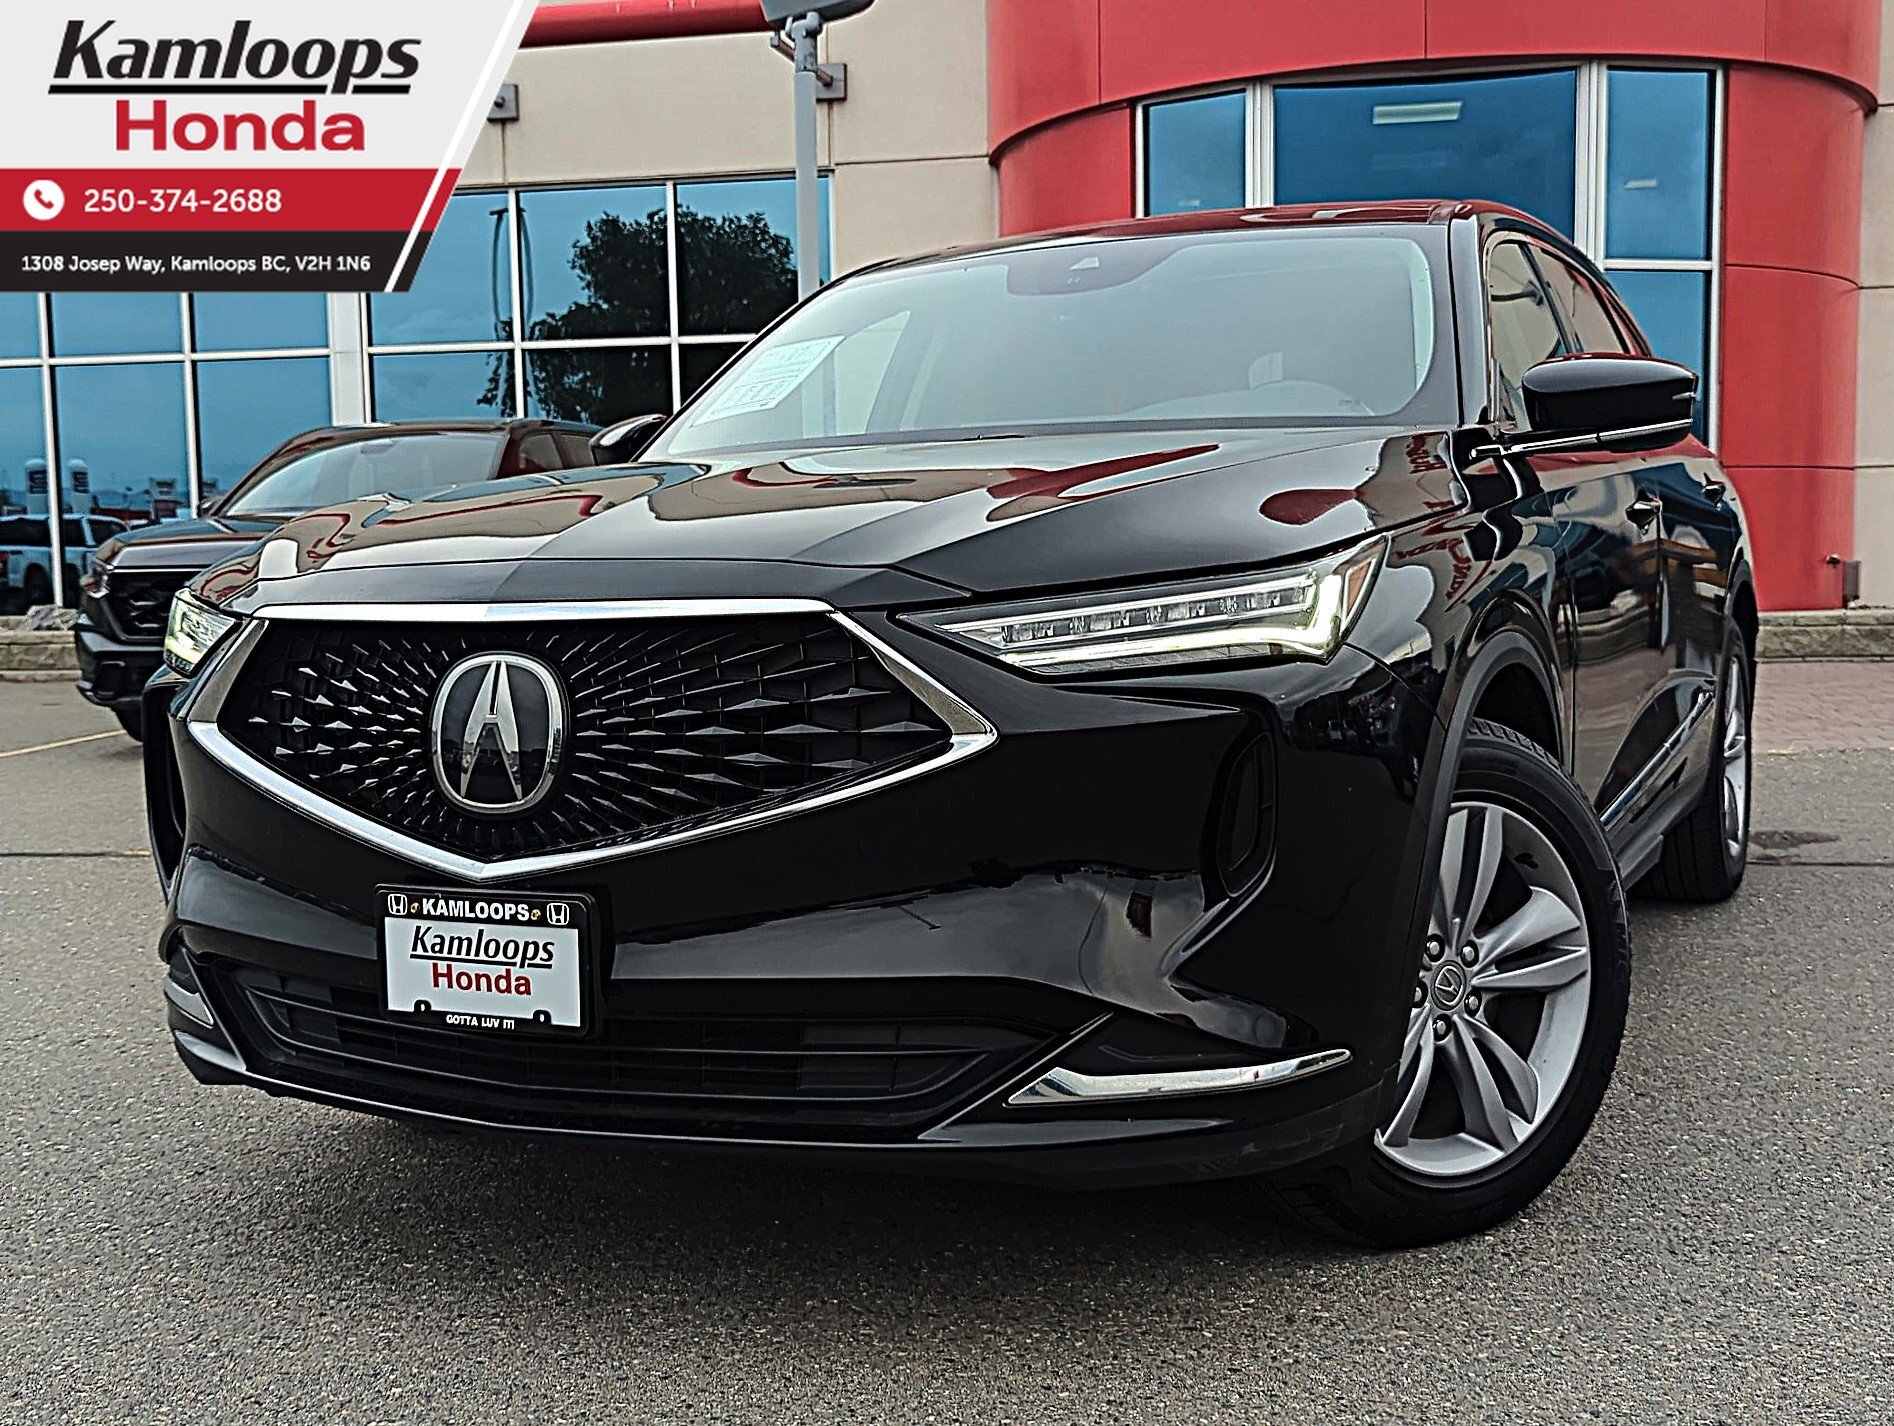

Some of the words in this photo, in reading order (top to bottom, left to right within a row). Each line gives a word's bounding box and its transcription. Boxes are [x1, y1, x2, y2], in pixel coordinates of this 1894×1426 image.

[422, 898, 530, 920] KAMLOOPS
[411, 925, 555, 968] Kamloops
[432, 963, 532, 995] Honda
[446, 1014, 478, 1026] GOTTA
[481, 1017, 499, 1028] LUV
